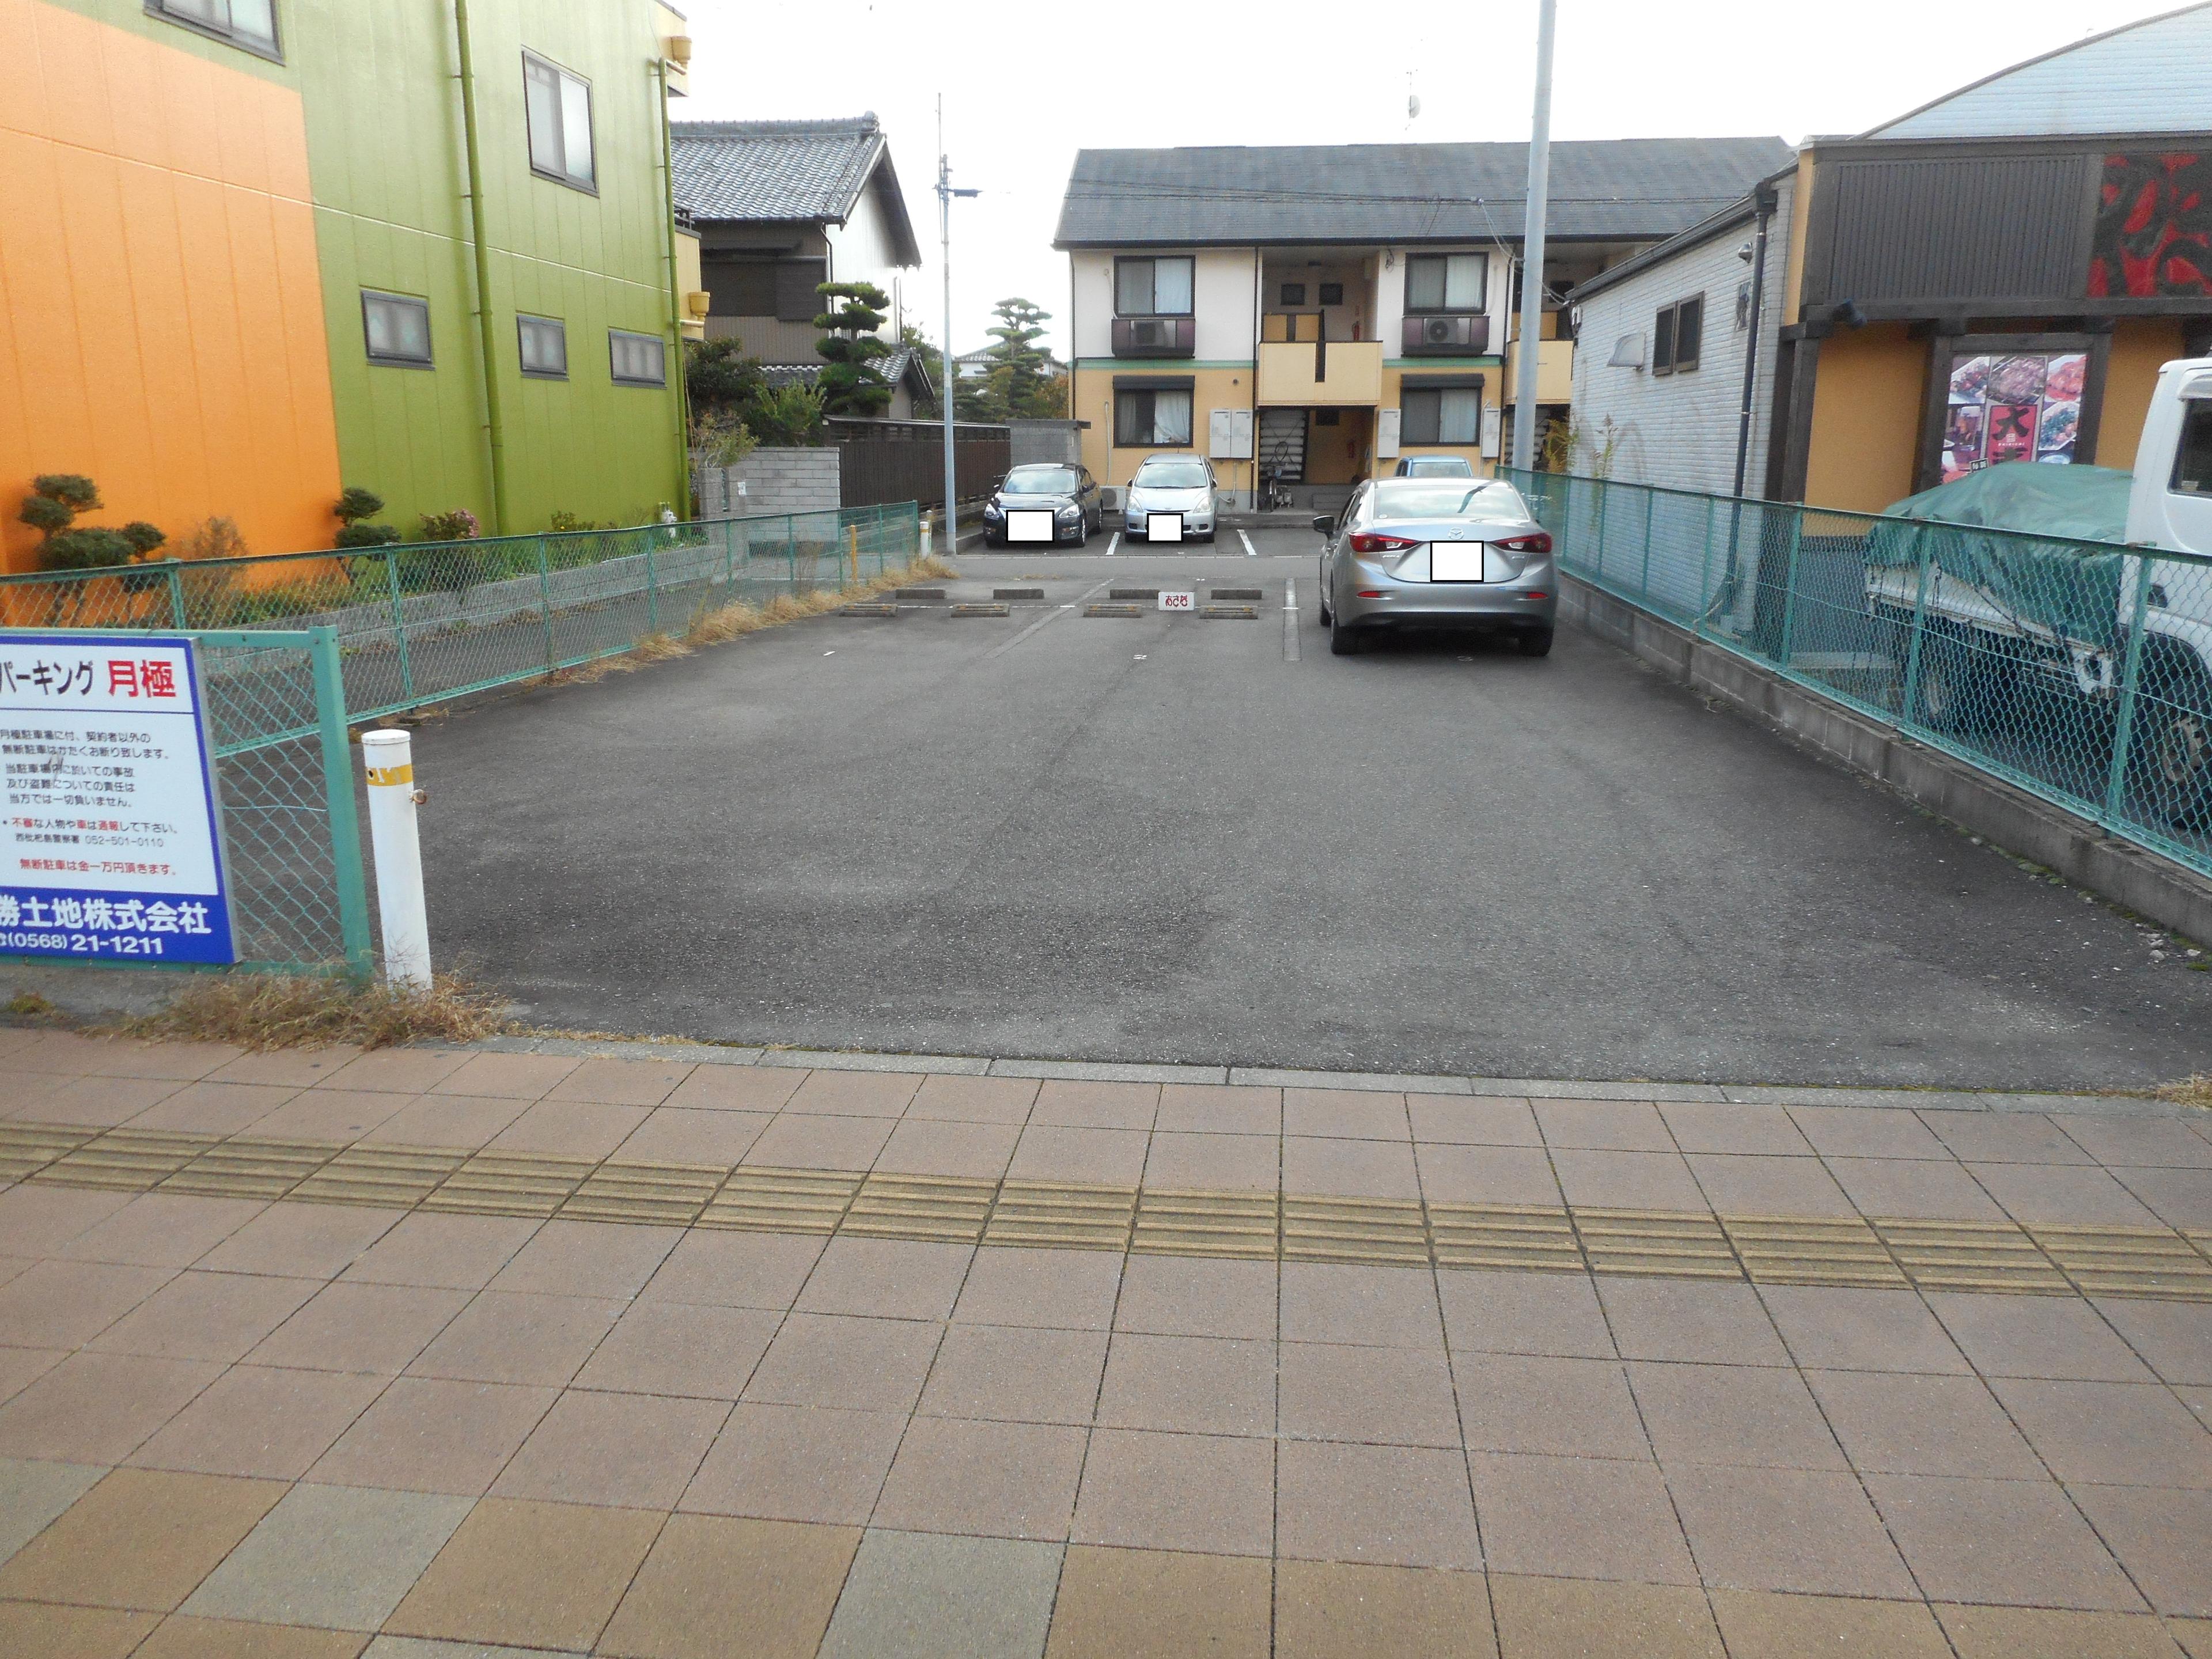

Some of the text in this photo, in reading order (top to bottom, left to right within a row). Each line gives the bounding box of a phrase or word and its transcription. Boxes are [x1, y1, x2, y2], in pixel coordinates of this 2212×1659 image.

[0, 659, 177, 698] パーキング 月極
[85, 835, 164, 847] 052-501-0110
[72, 934, 164, 955] 21-1211
